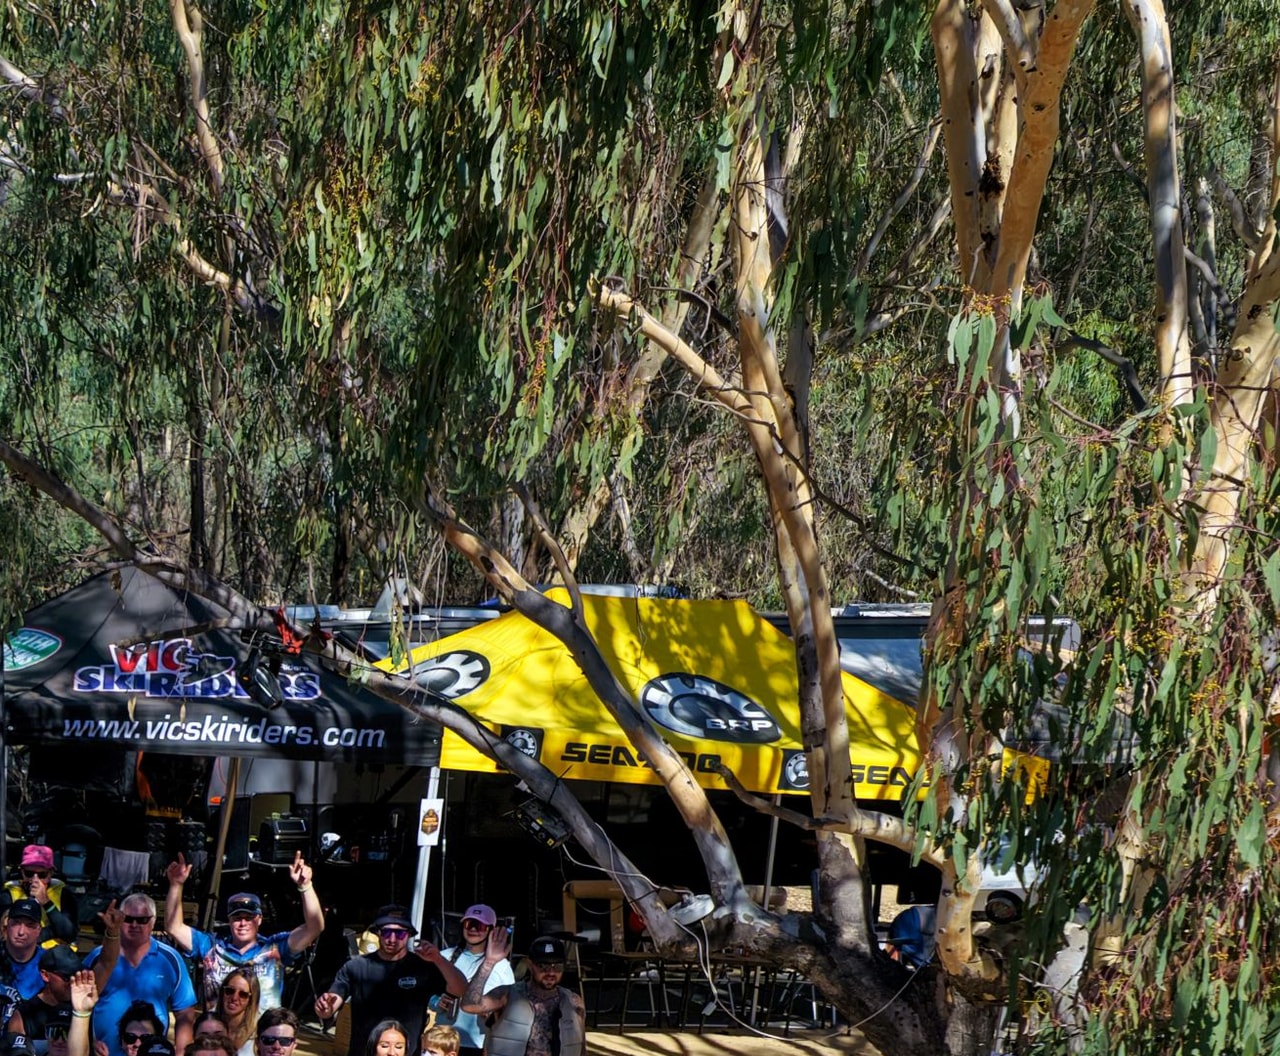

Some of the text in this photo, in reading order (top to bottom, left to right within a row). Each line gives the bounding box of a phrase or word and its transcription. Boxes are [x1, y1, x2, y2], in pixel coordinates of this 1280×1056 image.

[110, 638, 193, 673] VIC
[62, 713, 387, 749] www.vicskiriders.com
[705, 717, 772, 732] BRP
